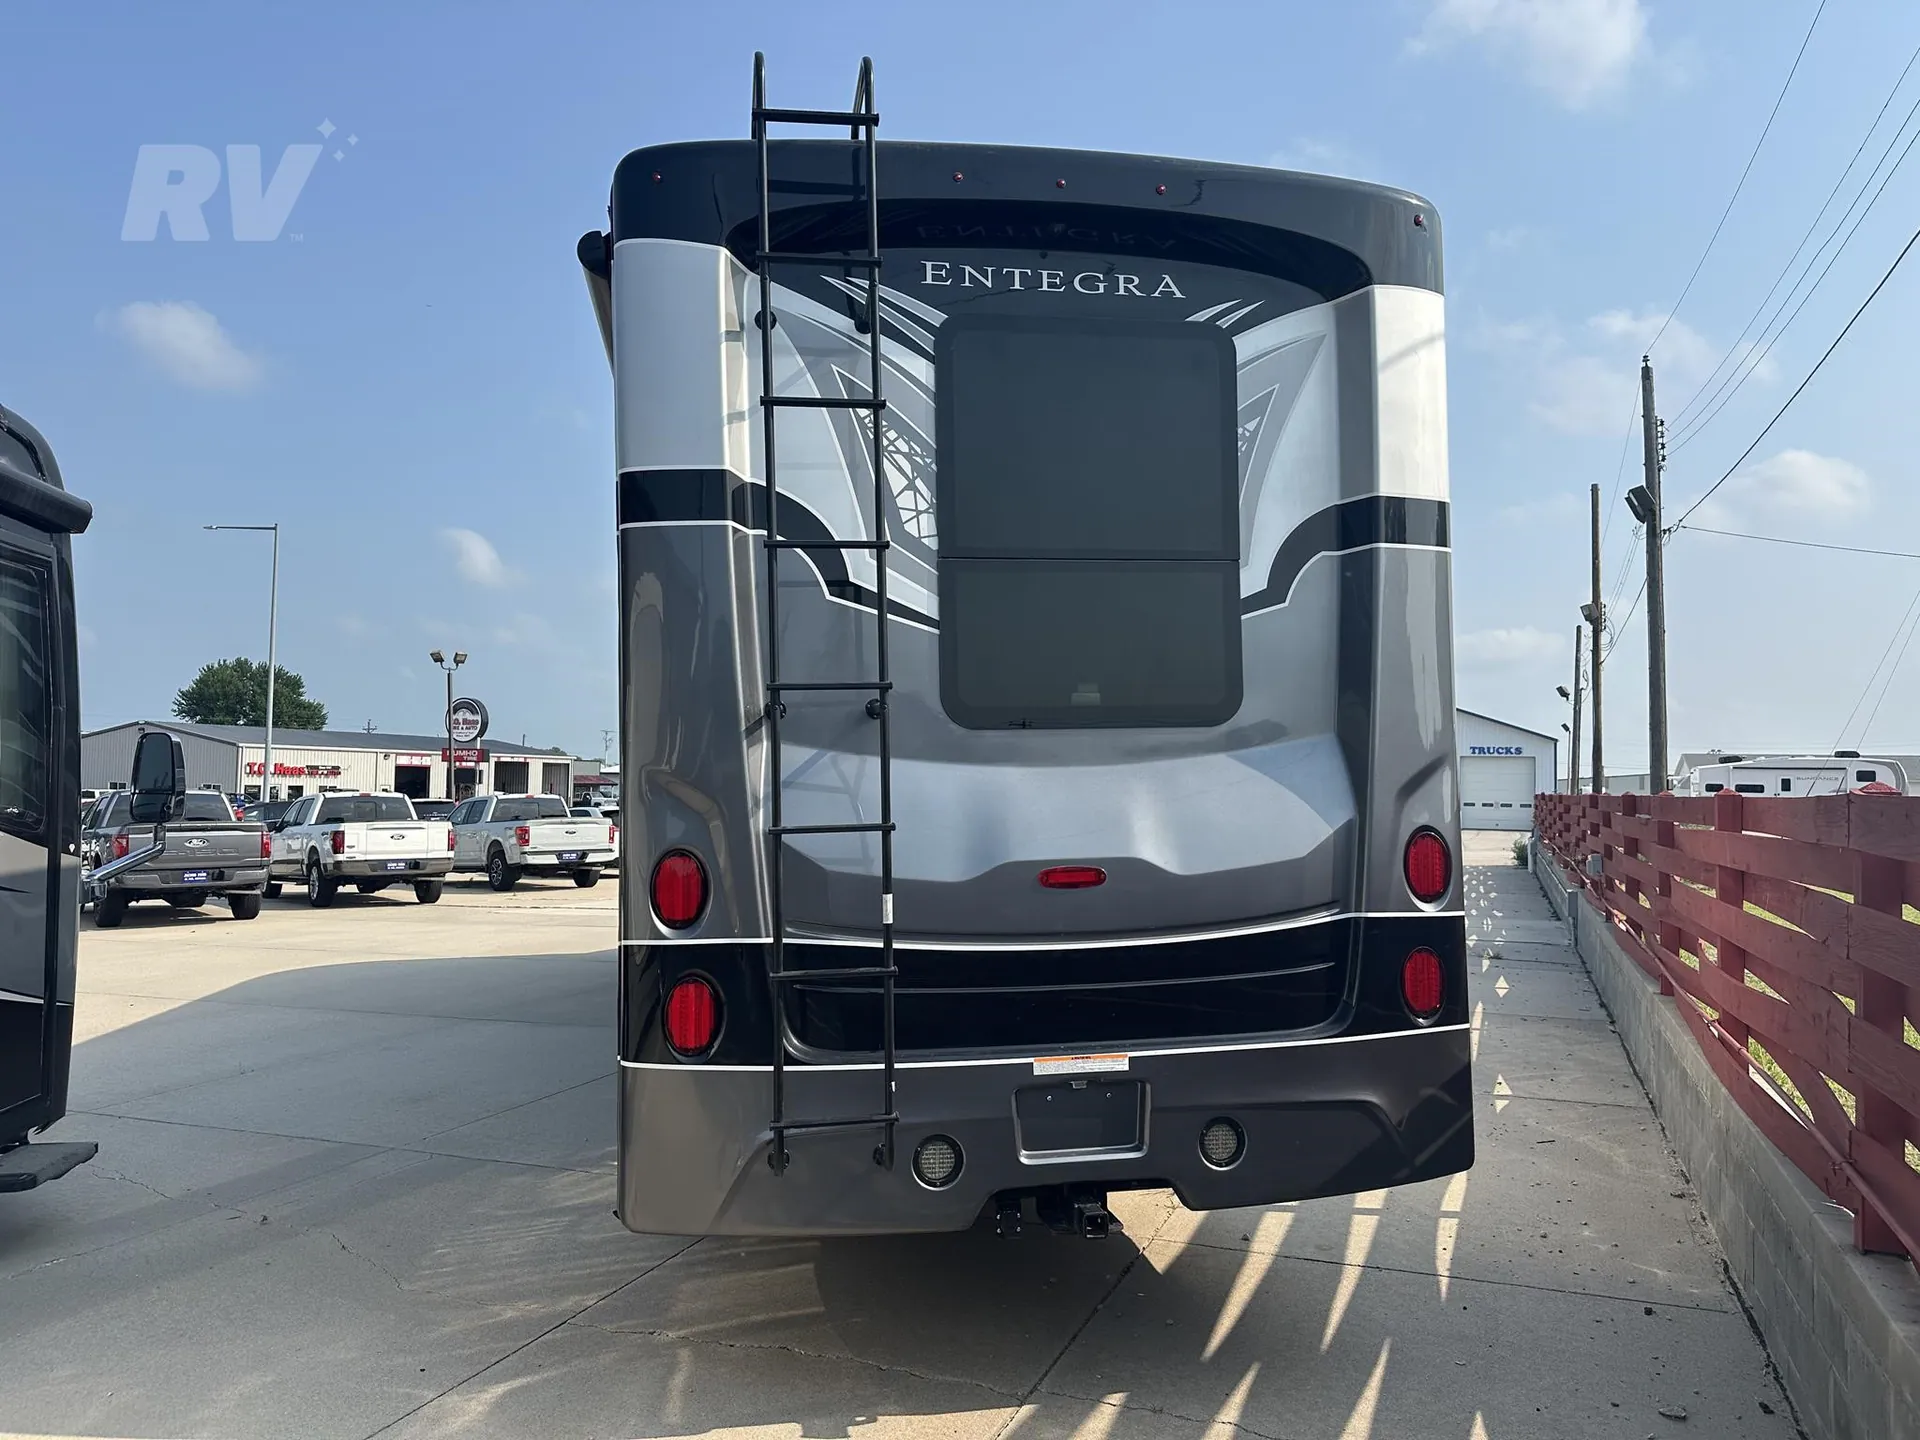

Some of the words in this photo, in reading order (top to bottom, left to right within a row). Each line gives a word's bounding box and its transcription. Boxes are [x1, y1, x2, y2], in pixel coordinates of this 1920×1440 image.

[920, 260, 1187, 299] ENTEGRA
[1469, 746, 1523, 755] TRUCKS
[274, 763, 305, 776] Haas
